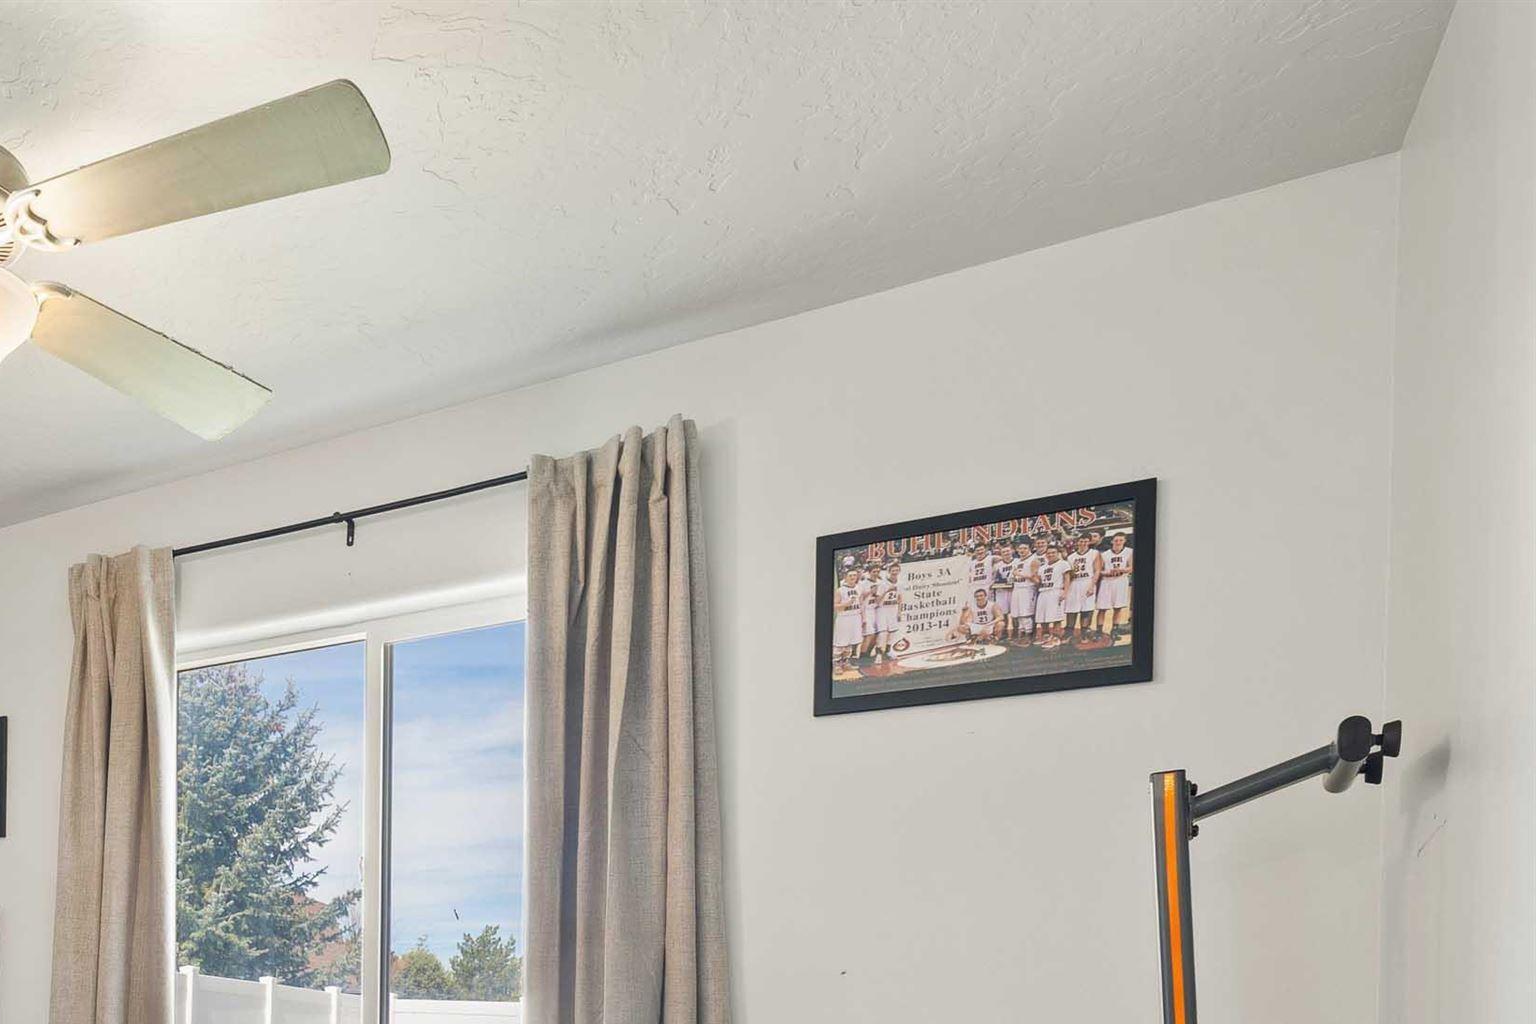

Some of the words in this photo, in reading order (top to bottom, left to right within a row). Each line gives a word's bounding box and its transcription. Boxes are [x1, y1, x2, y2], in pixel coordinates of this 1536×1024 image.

[958, 507, 1097, 546] INDIANS
[907, 572, 933, 582] Boys
[914, 590, 943, 599] State
[900, 596, 957, 612] Basketball
[906, 619, 950, 634] 2013-14
